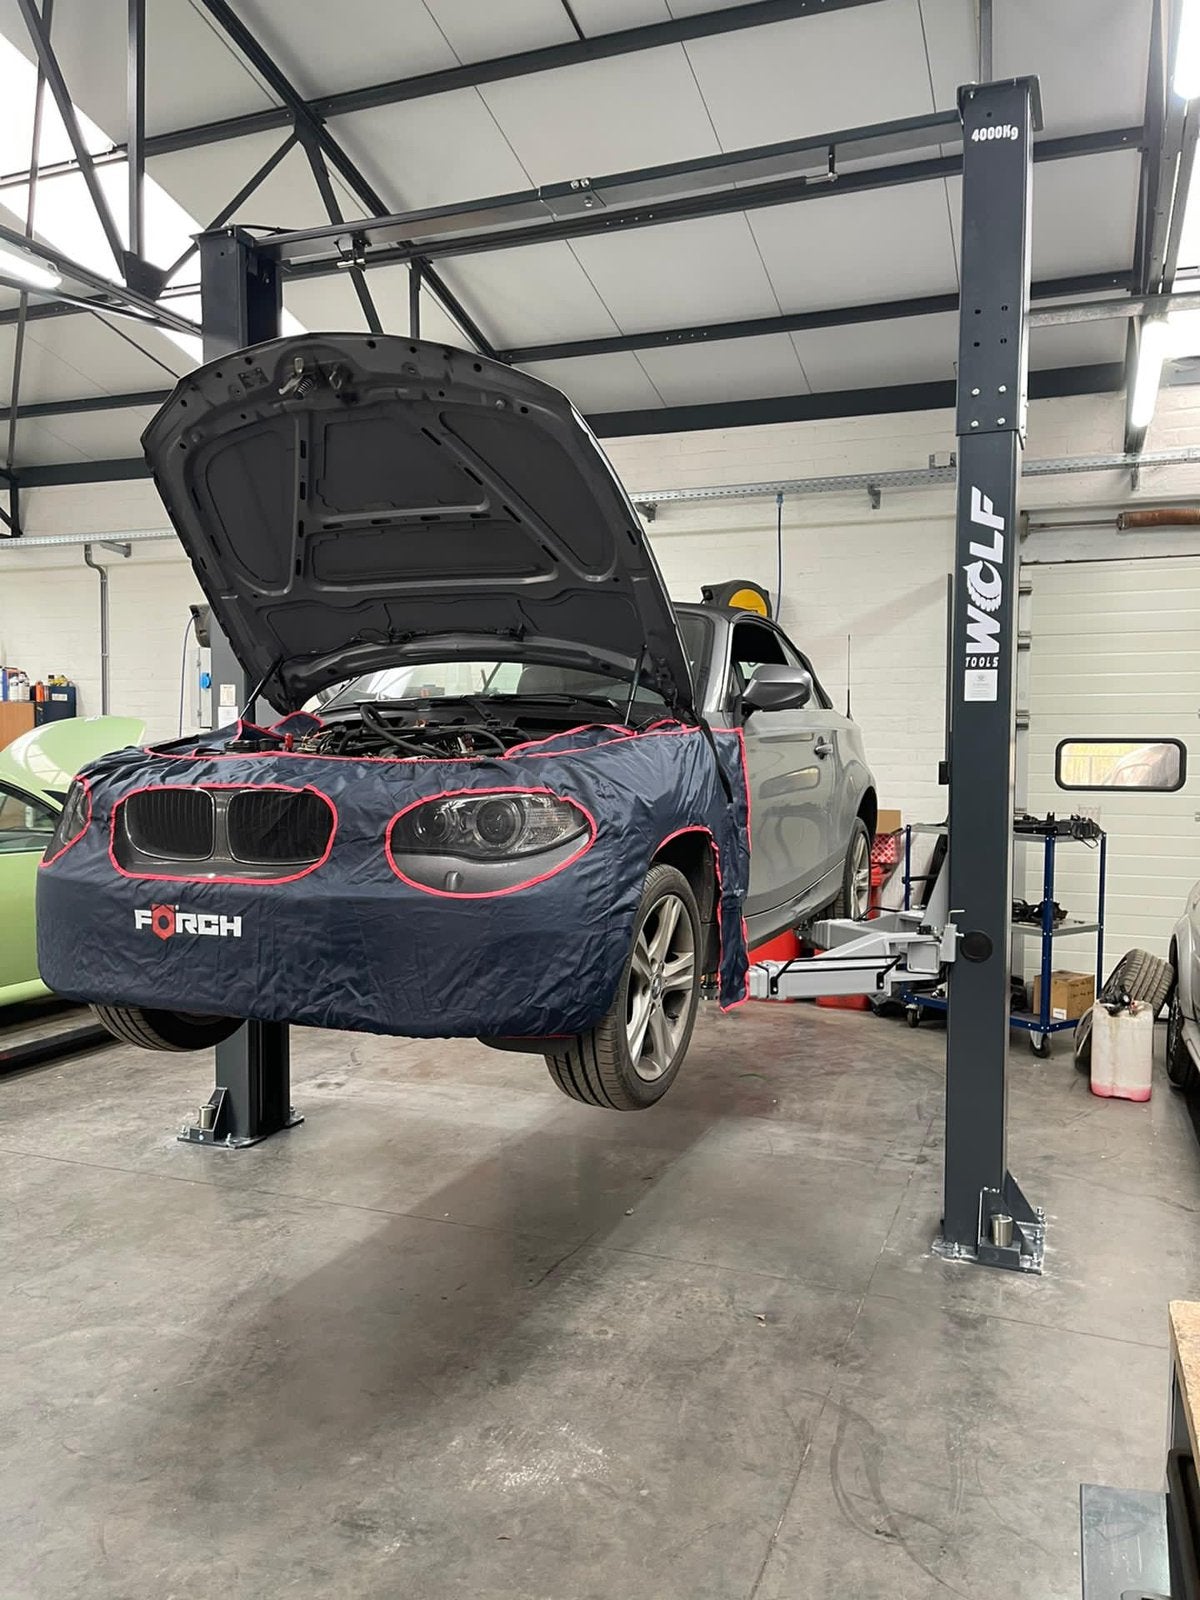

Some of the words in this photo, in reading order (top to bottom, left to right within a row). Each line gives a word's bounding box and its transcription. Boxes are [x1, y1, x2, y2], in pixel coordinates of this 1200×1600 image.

[972, 124, 1019, 142] 4000Kg
[963, 486, 1005, 654] WOLF
[965, 656, 999, 668] TOOLS
